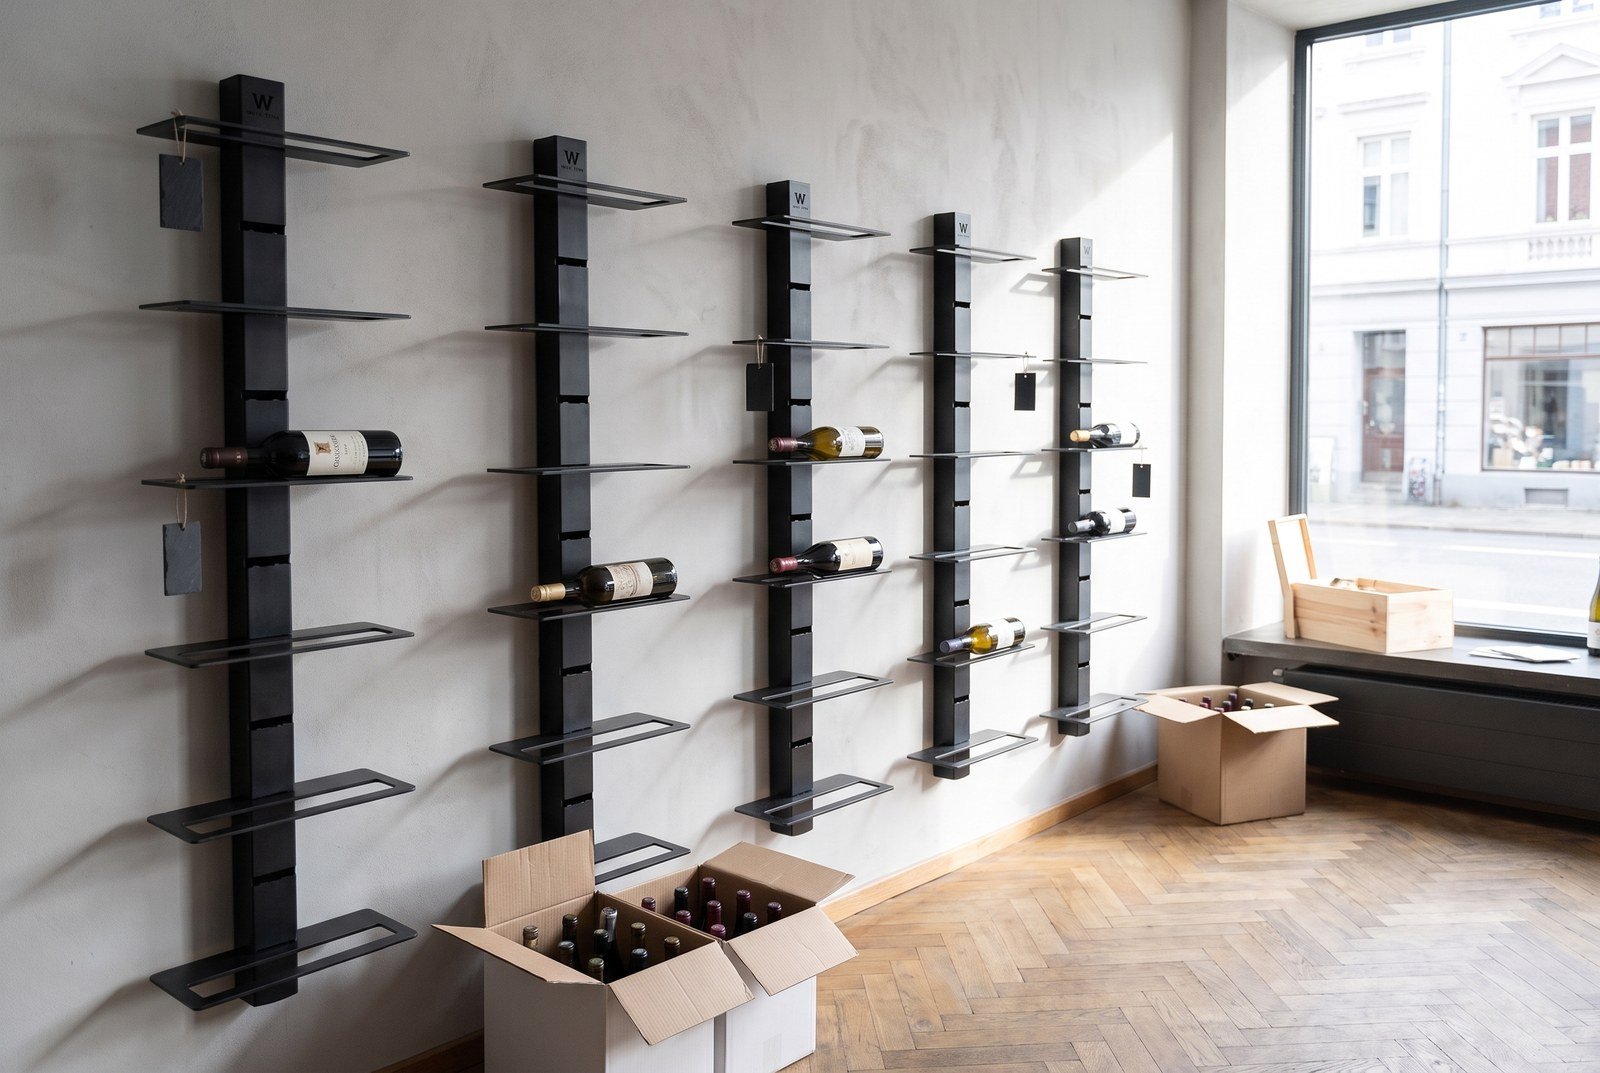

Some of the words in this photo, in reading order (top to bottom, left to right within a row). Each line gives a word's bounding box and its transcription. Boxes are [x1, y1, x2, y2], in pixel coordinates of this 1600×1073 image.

[251, 92, 274, 111] W
[564, 150, 580, 165] W
[794, 192, 806, 205] W
[959, 222, 968, 234] W
[1083, 245, 1091, 255] W
